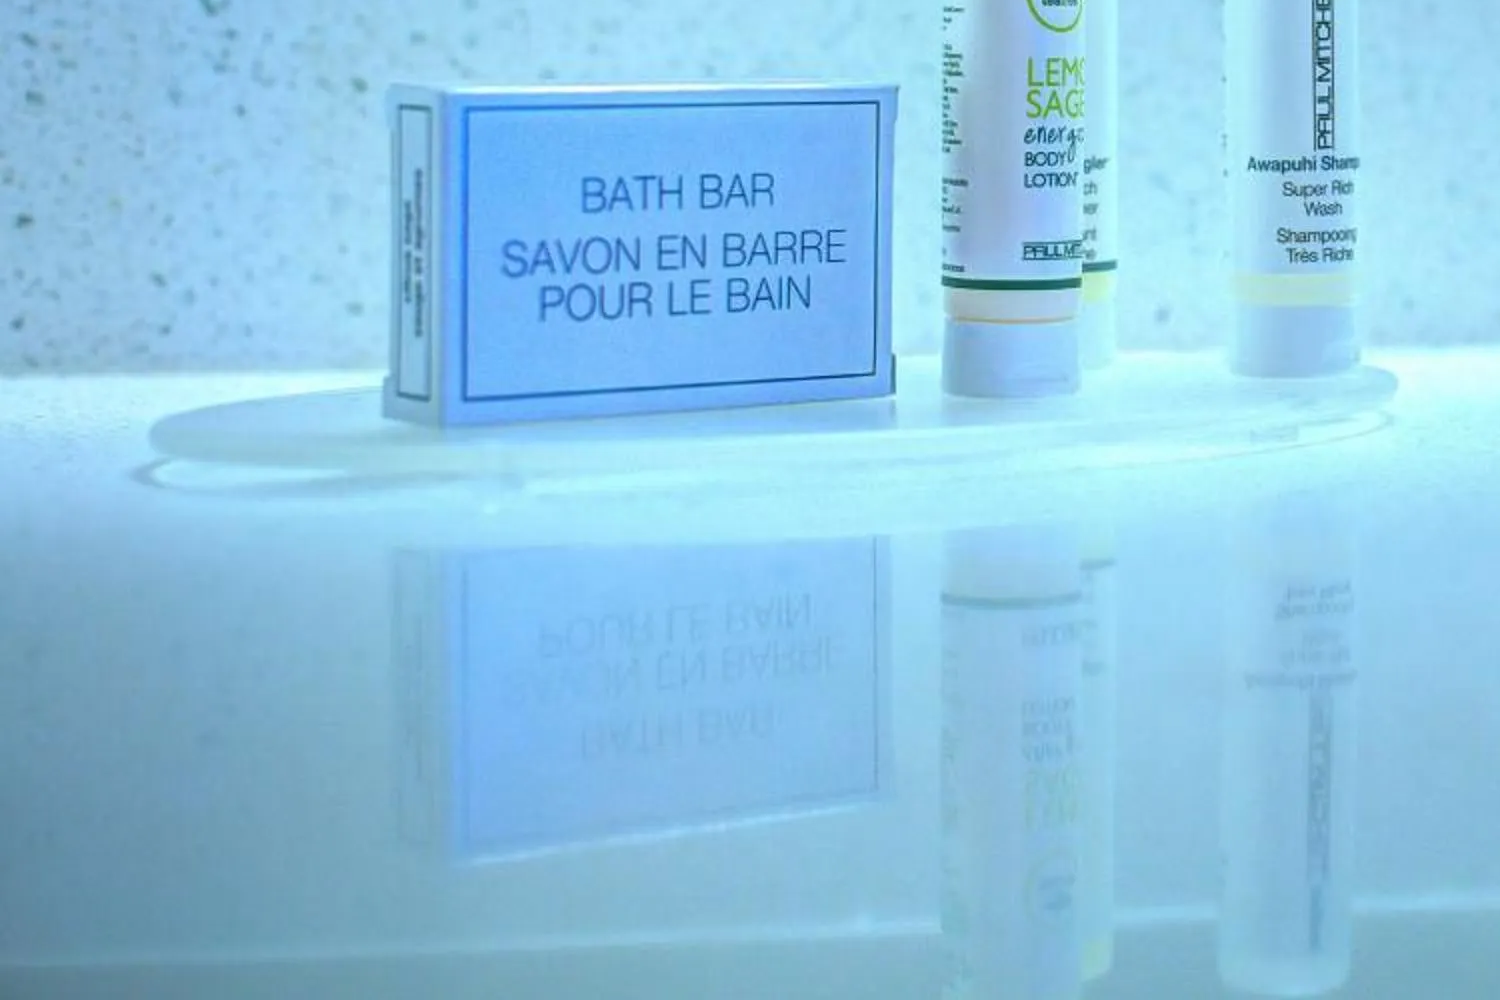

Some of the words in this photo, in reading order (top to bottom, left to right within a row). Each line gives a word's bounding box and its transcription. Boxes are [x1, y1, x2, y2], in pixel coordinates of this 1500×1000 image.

[1315, 85, 1333, 151] PAUL
[1024, 151, 1067, 167] BODY
[1247, 156, 1317, 175] Awapuhi
[1024, 172, 1078, 189] LOTION
[582, 175, 685, 214] BATH
[699, 173, 774, 209] BAR
[1282, 181, 1328, 200] Super
[1304, 201, 1343, 216] Wash
[501, 235, 641, 279] SAVON
[657, 234, 707, 271] EN
[723, 229, 847, 268] BARRE
[539, 281, 652, 322] POUR
[669, 280, 712, 316] LE
[726, 275, 811, 314] BAIN
